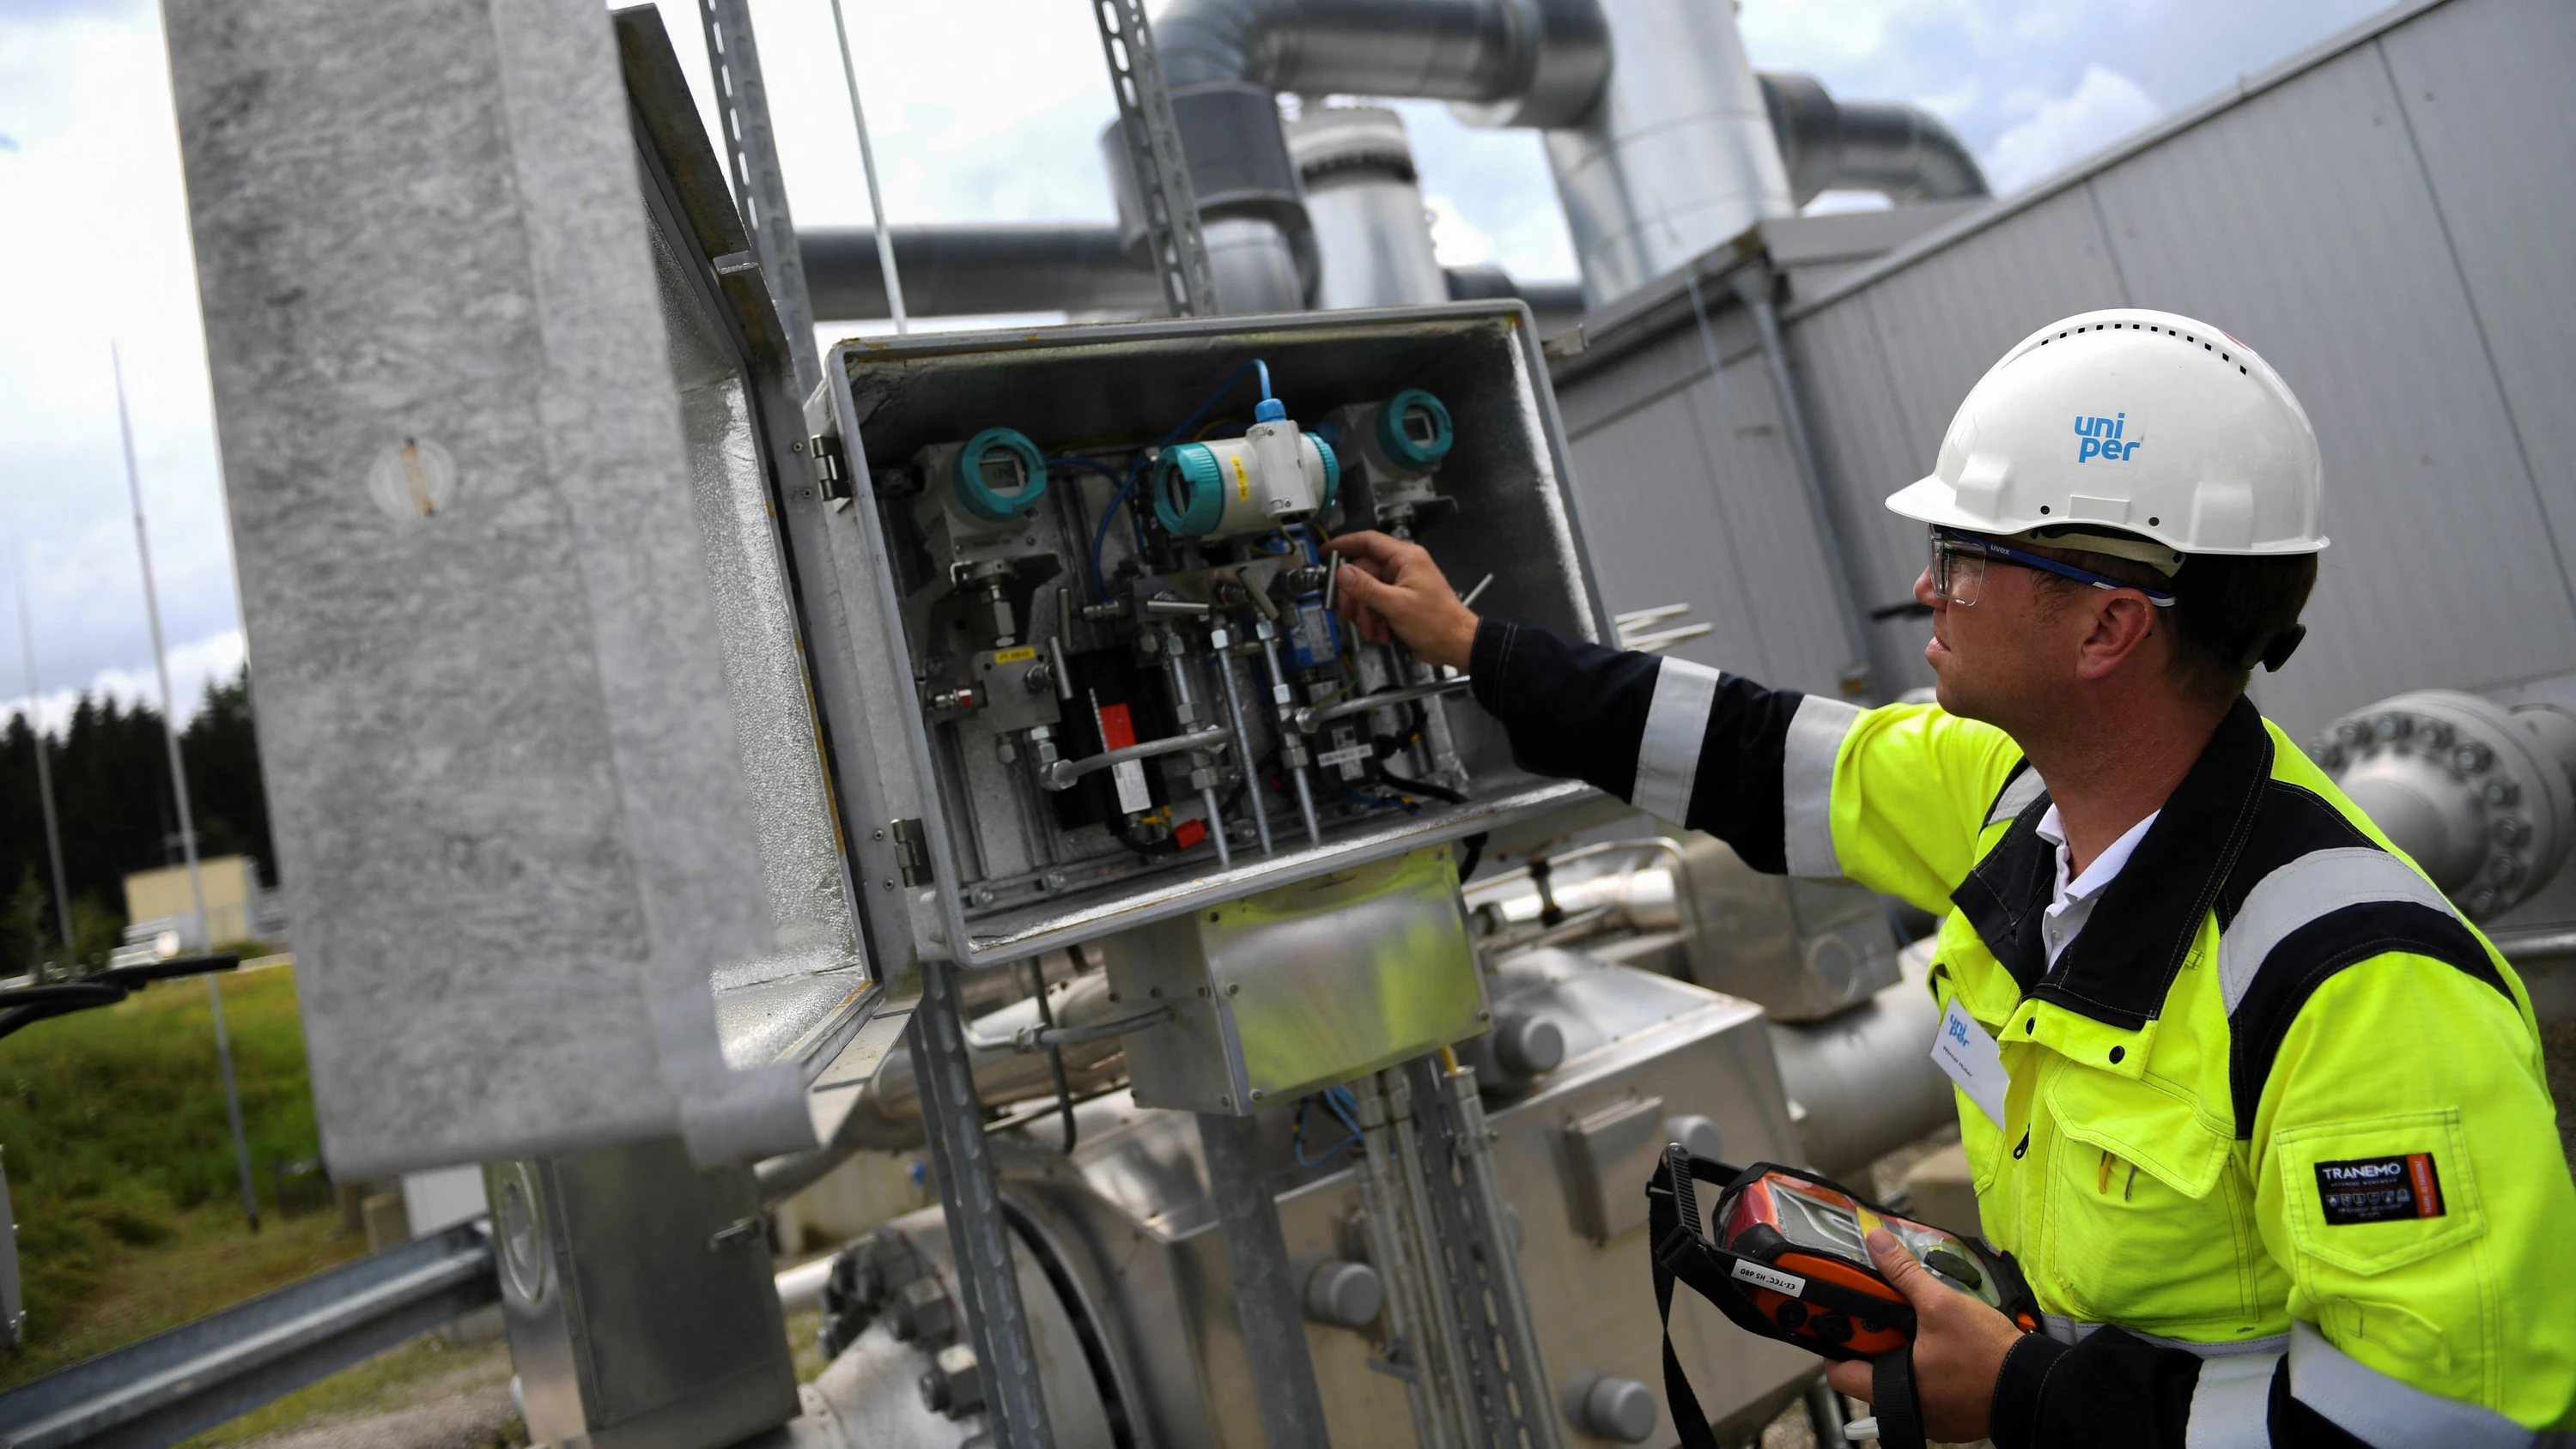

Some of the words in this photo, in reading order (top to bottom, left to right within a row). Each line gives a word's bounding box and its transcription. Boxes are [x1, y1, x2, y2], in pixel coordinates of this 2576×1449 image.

[2074, 412, 2125, 440] uni
[2079, 438, 2141, 464] per
[1990, 544, 2010, 555] uvex
[1949, 1014, 1967, 1036] uni
[1949, 1026, 1970, 1047] per
[2322, 1162, 2402, 1180] TRANEMO
[1740, 1268, 1755, 1277] 680
[1755, 1273, 1766, 1282] HS
